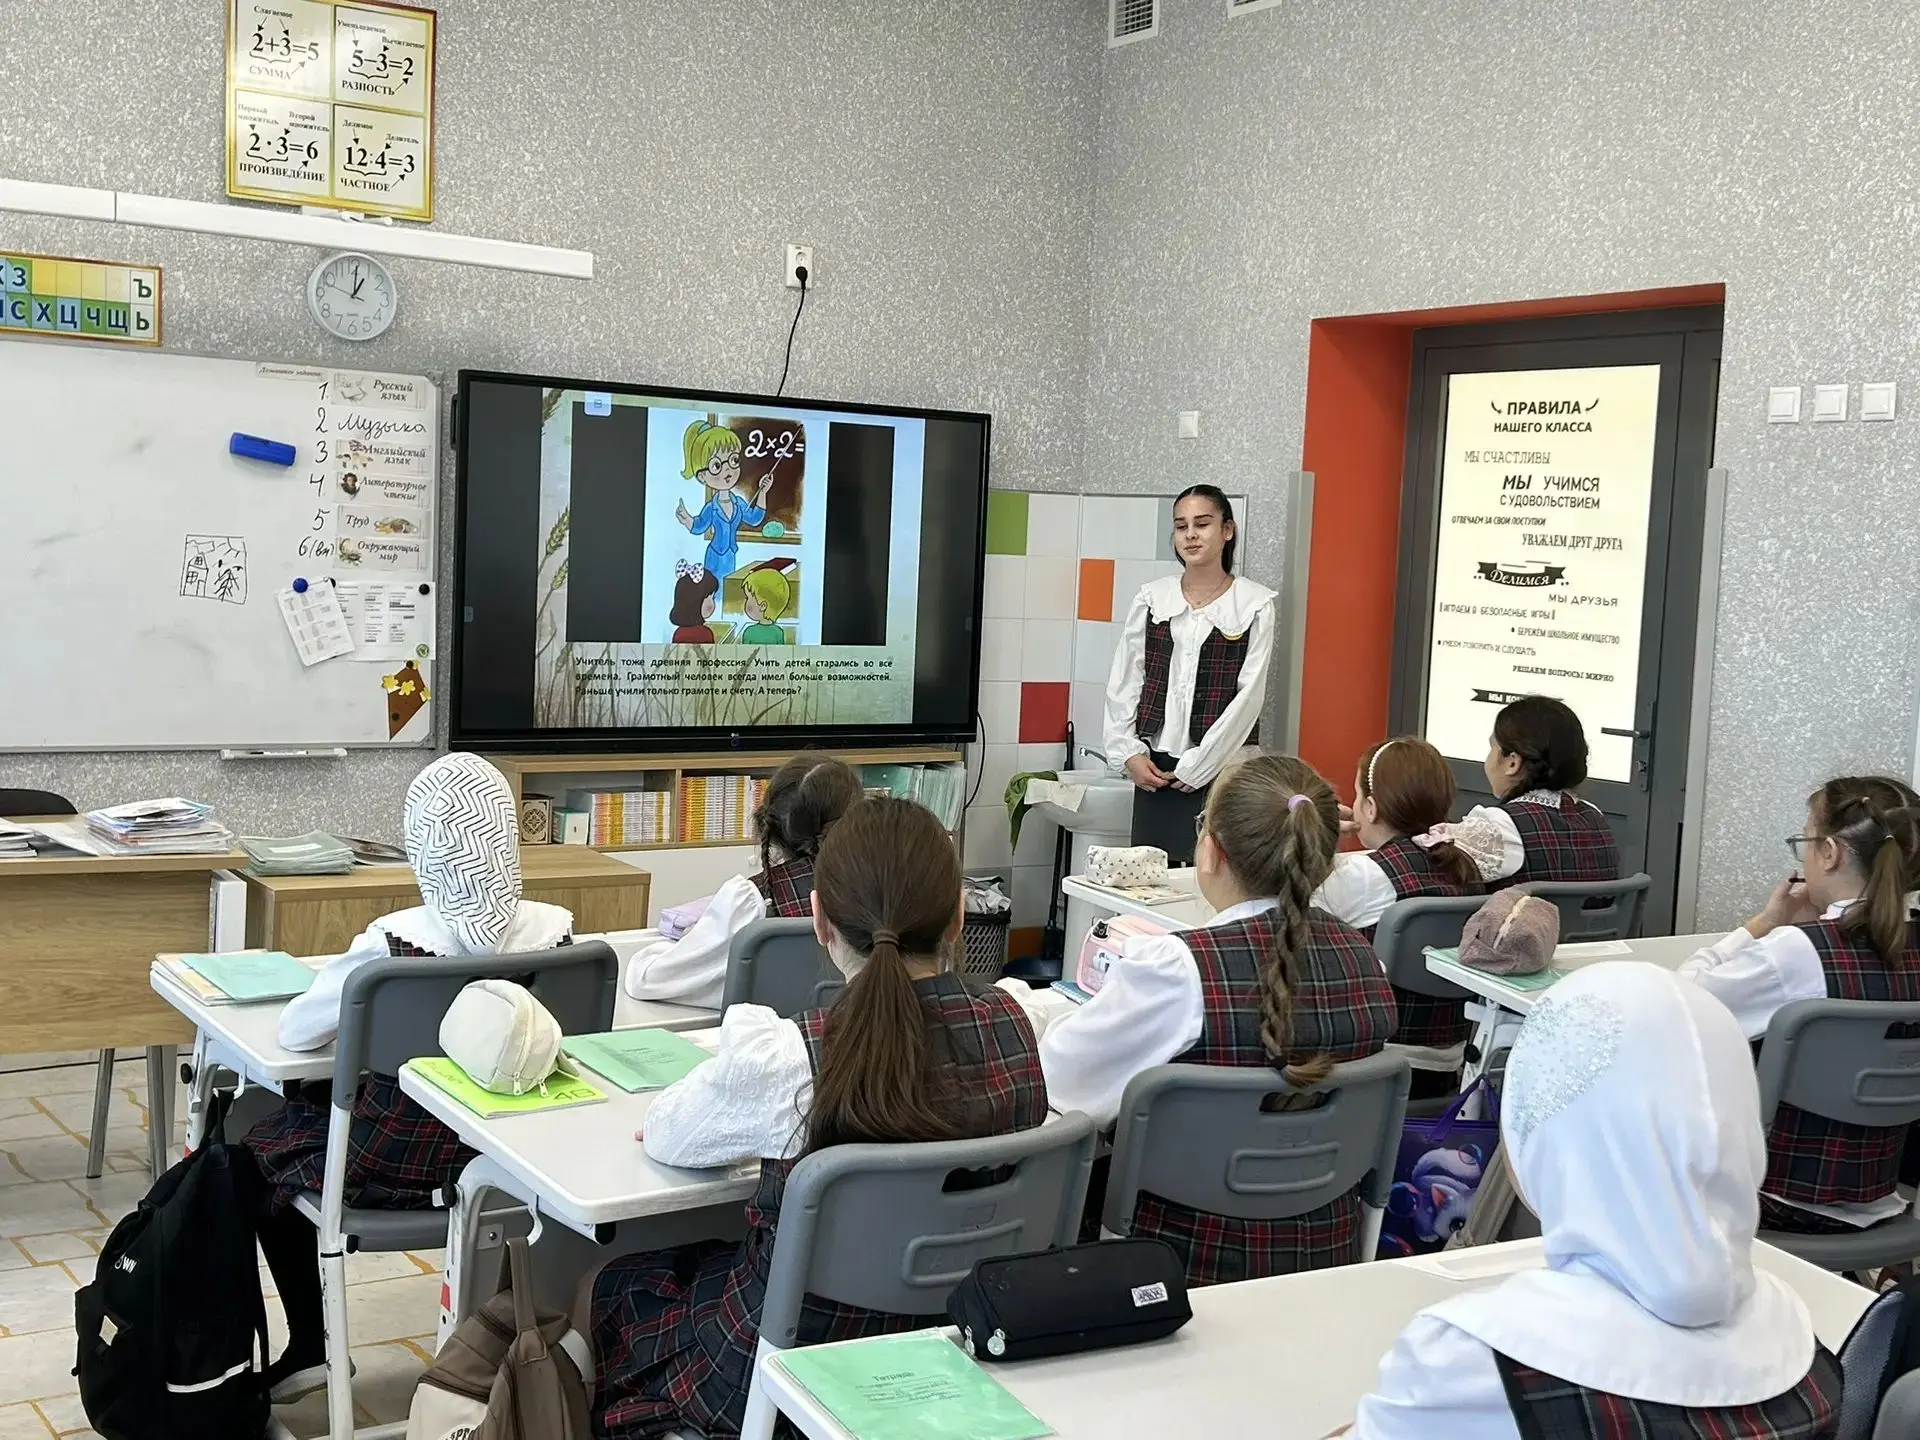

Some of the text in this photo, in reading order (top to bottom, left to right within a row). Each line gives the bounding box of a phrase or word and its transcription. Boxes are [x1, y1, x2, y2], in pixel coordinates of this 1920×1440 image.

[252, 33, 319, 61] 2+3=5
[249, 65, 291, 80] СУММА
[341, 80, 395, 96] РАЗНОСТЬ
[239, 163, 326, 182] ПРОИЗВЕДЕНИЕ
[341, 178, 390, 192] ЧАСТНОЕ
[133, 278, 153, 298] Ъ
[374, 274, 385, 291] 2
[316, 286, 325, 302] 9
[380, 291, 390, 308] 3
[320, 303, 331, 319] 8
[372, 308, 382, 322] 4
[60, 305, 78, 329] Ц
[86, 307, 100, 326] Ч
[108, 309, 128, 333] Щ
[136, 311, 150, 331] Ь
[335, 313, 343, 330] 7
[362, 316, 372, 332] 5
[347, 320, 357, 335] 6
[373, 379, 414, 393] Русский
[380, 392, 408, 402] язык
[1507, 401, 1581, 415] ПРАВИЛА
[315, 406, 329, 434] 2
[338, 411, 427, 441] Музыка
[1494, 422, 1593, 433] НАШЕГО КЛАССА
[315, 440, 329, 464] 3
[362, 443, 427, 459] Английский
[1464, 451, 1550, 464] МЫ СЧАСТЛИВЫ
[384, 456, 412, 467] язык
[360, 476, 427, 492] Литературное
[1502, 475, 1600, 492] МЫ УЧИМСЯ
[383, 491, 417, 501] чтение
[1500, 495, 1600, 509] С УДОВОЛЬСТВИЕМ
[312, 508, 331, 531] 5
[346, 514, 370, 528] Труд
[1451, 516, 1546, 526] ОТВЕЧАЕМ ЗА СВОИ ПОСТУПКИ
[357, 540, 420, 554] Окружающий
[1522, 533, 1623, 551] УВАЖАЕМ ДРУГ ДРУГА
[379, 553, 399, 563] мир
[1489, 569, 1550, 586] Делимся
[1548, 594, 1618, 607] МЫ ДРУЗЬЯ
[1480, 606, 1528, 618] БЕЗОПАСНЫЕ
[1581, 633, 1620, 644] ИМУЩЕСТВО
[1502, 645, 1537, 656] СЛУШАТЬ
[575, 657, 616, 667] Учитель
[622, 659, 645, 667] тоже
[650, 659, 691, 668] древняя
[754, 658, 780, 668] Учить
[785, 658, 811, 668] детей
[815, 660, 859, 668] старались
[575, 673, 621, 682] времена.
[627, 672, 680, 682] Грамотный
[728, 674, 757, 682] всегда
[789, 672, 823, 681] больше
[827, 672, 892, 681] возможностей.
[1547, 668, 1585, 679] ВОПРОСЫ
[575, 687, 613, 695] Раньше
[615, 688, 645, 697] учили
[647, 688, 680, 696] только
[682, 688, 719, 696] грамоте
[758, 687, 765, 695] А
[766, 686, 802, 697] теперь?
